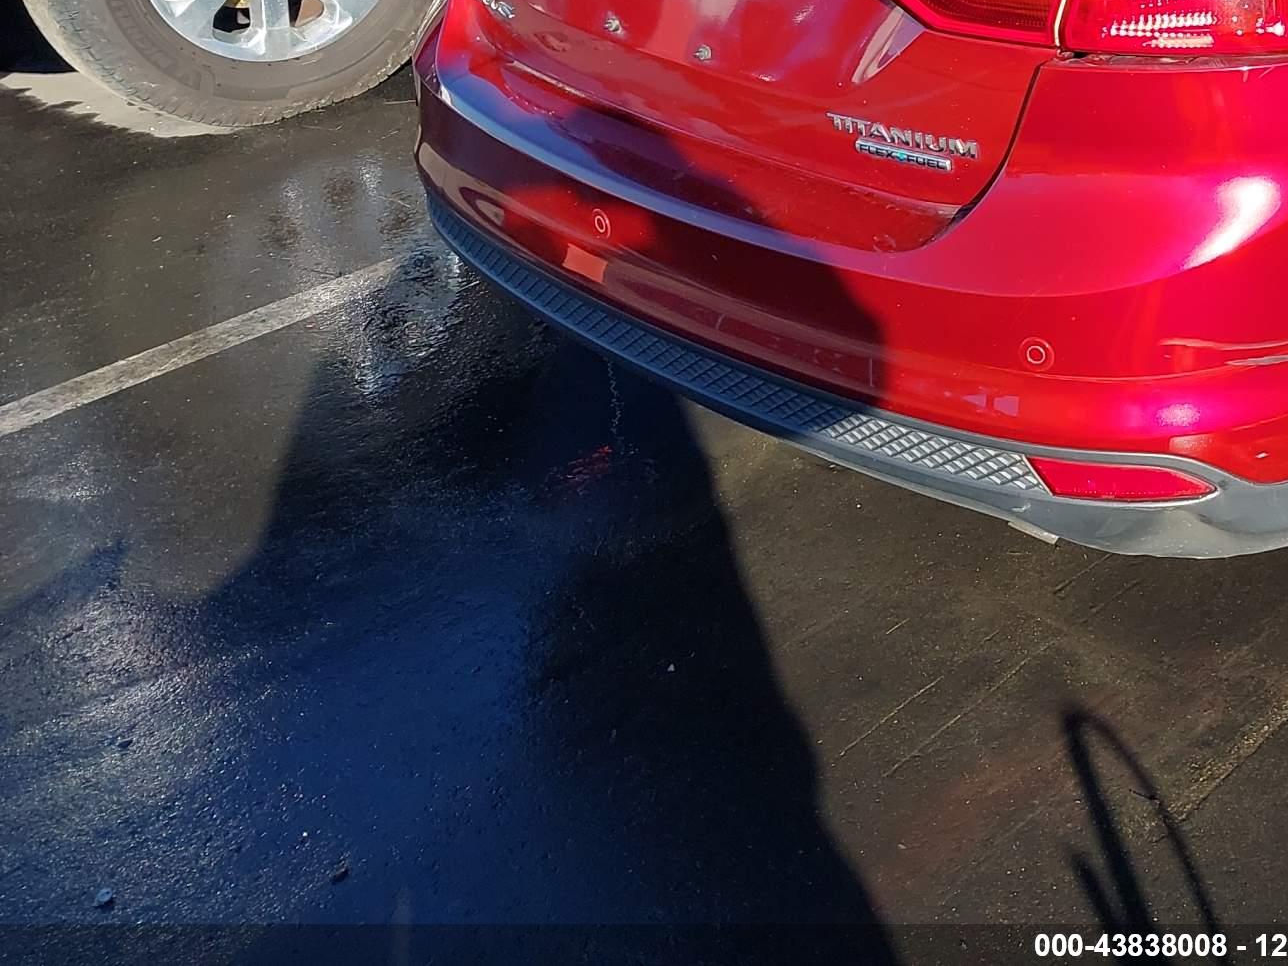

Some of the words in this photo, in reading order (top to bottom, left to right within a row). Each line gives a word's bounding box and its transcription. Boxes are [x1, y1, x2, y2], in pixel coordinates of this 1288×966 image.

[825, 112, 979, 158] TITANIUM
[857, 143, 896, 160] FLEX
[905, 154, 949, 170] FUEL
